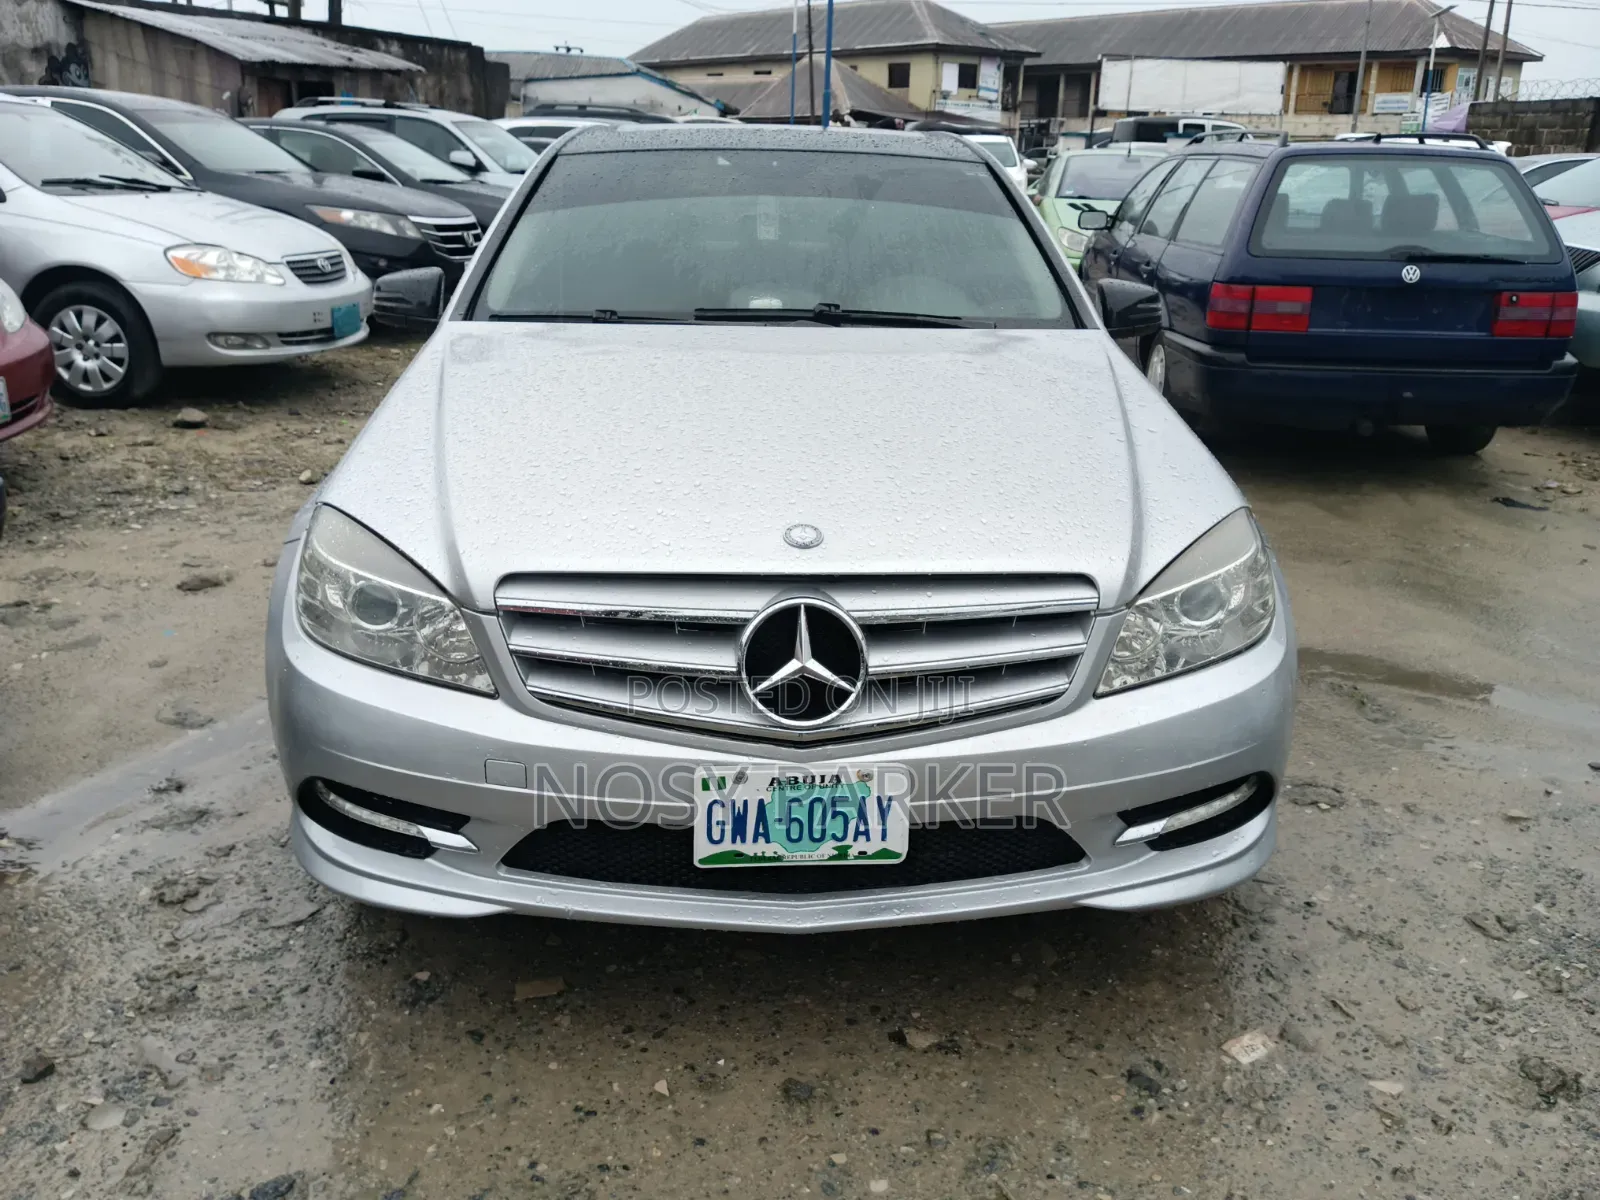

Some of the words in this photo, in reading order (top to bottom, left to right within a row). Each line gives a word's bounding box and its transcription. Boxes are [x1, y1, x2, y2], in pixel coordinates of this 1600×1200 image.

[768, 774, 842, 787] ABUJA
[766, 784, 802, 792] CENTRE
[706, 795, 893, 845] GWA-605AY
